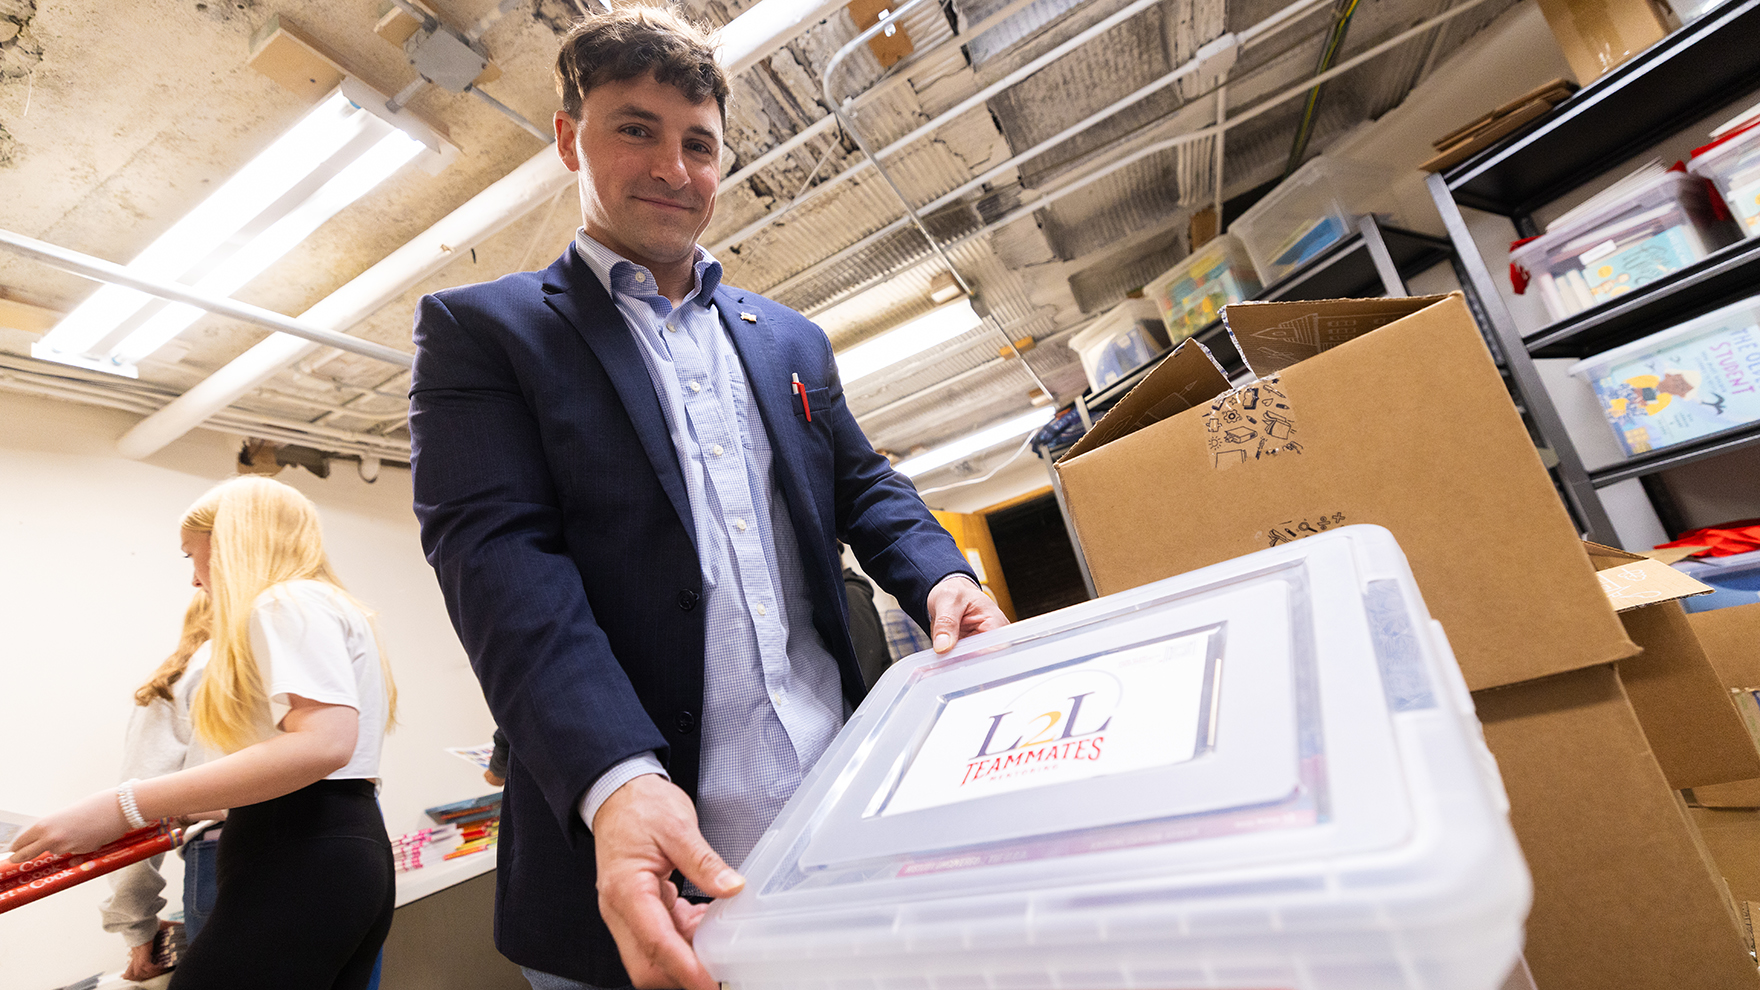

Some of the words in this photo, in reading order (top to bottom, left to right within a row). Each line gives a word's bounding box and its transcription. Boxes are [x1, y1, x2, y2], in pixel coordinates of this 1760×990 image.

[1709, 341, 1755, 395] STUDENT
[968, 691, 1112, 761] L2L
[960, 736, 1104, 787] TEAMMATES
[18, 864, 63, 884] Cook
[19, 853, 63, 872] Cook
[29, 868, 75, 889] Cook
